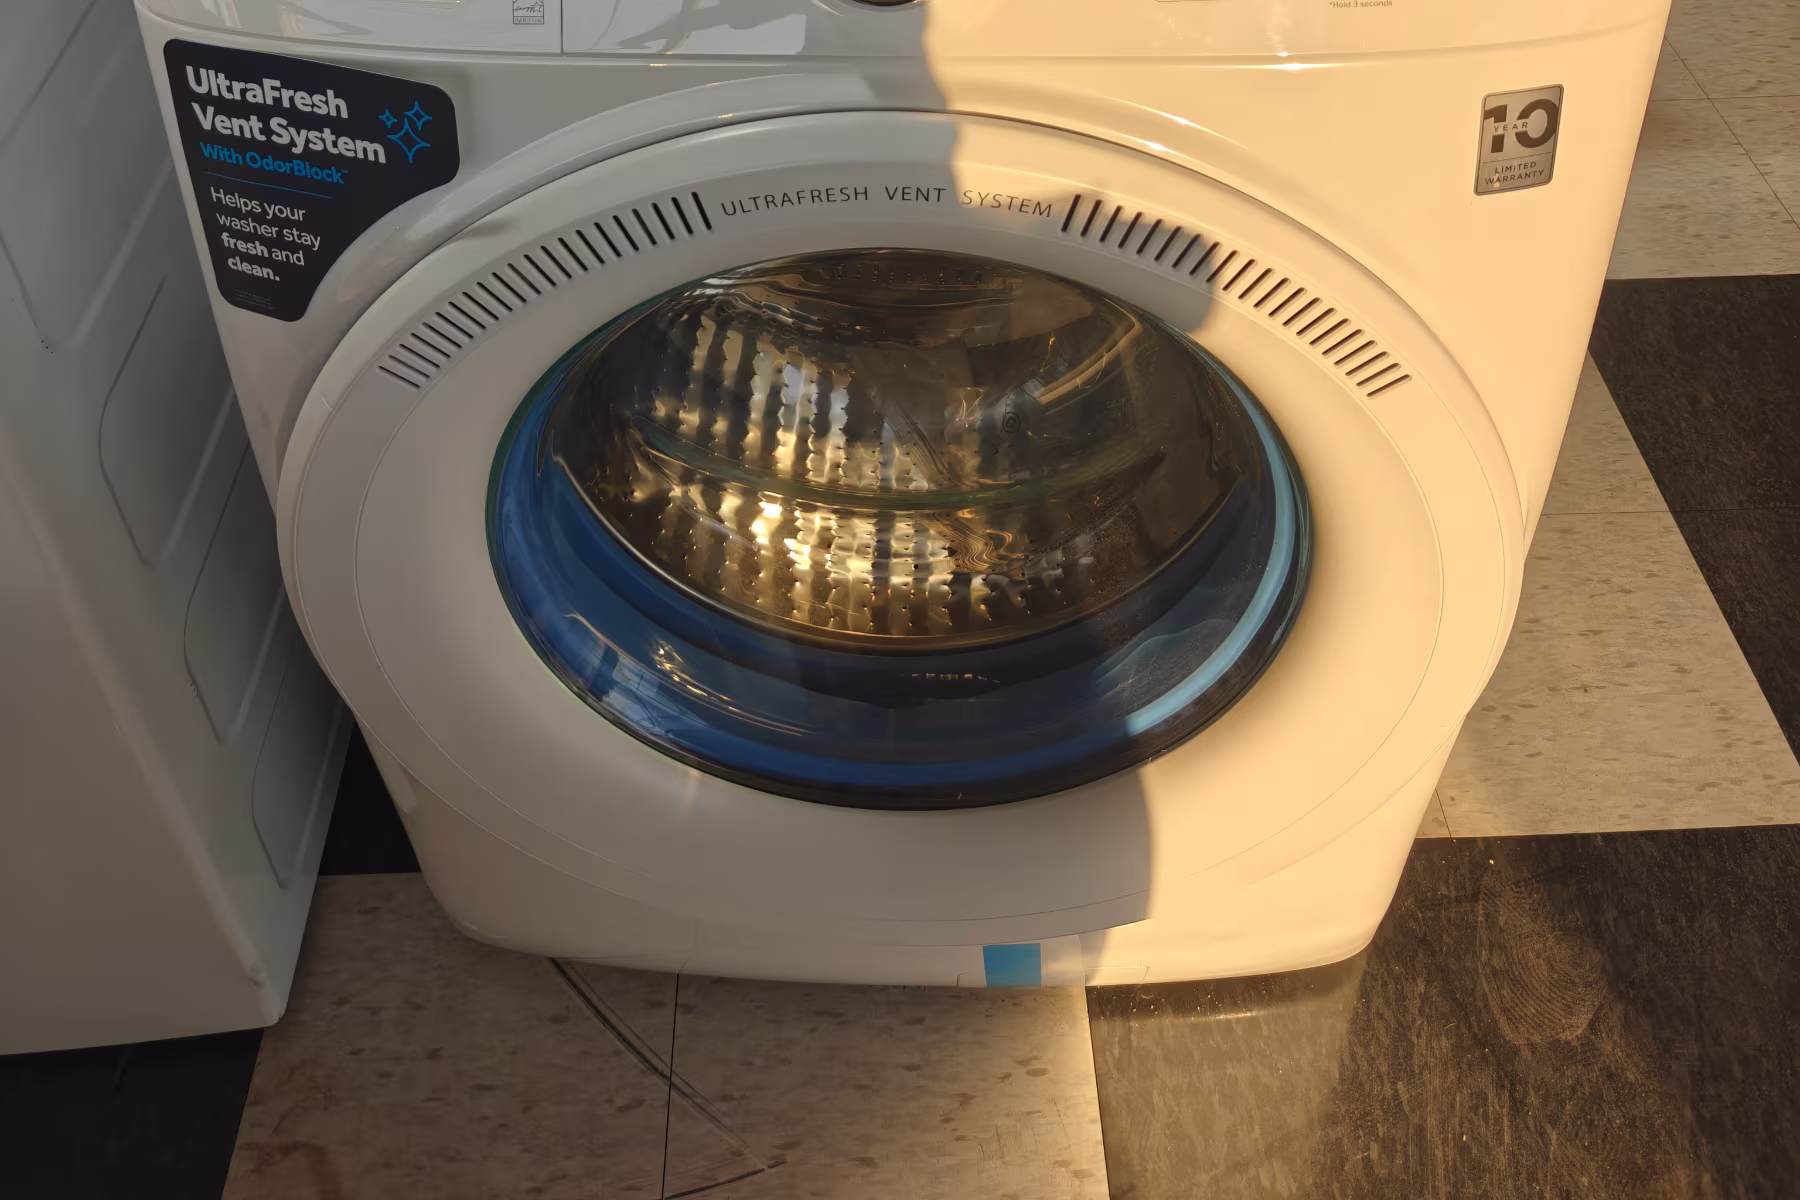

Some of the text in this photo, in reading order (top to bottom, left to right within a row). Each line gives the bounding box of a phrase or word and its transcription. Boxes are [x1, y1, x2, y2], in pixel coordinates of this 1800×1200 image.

[1353, 0, 1359, 8] 3
[1361, 0, 1393, 8] seconds
[185, 65, 349, 119] UltraFresh
[191, 102, 386, 164] Vent System
[1483, 98, 1559, 154] 10
[1493, 121, 1529, 133] YEAR
[200, 142, 244, 166] With
[1494, 161, 1537, 175] LIMITED
[1484, 168, 1545, 185] WARRANTY
[210, 186, 306, 221] Helps your
[720, 186, 1054, 218] ULTRAFRESH VENT SYSTEM
[216, 212, 321, 251] washer stay
[221, 232, 305, 266] fresh and
[227, 255, 281, 281] clean.
